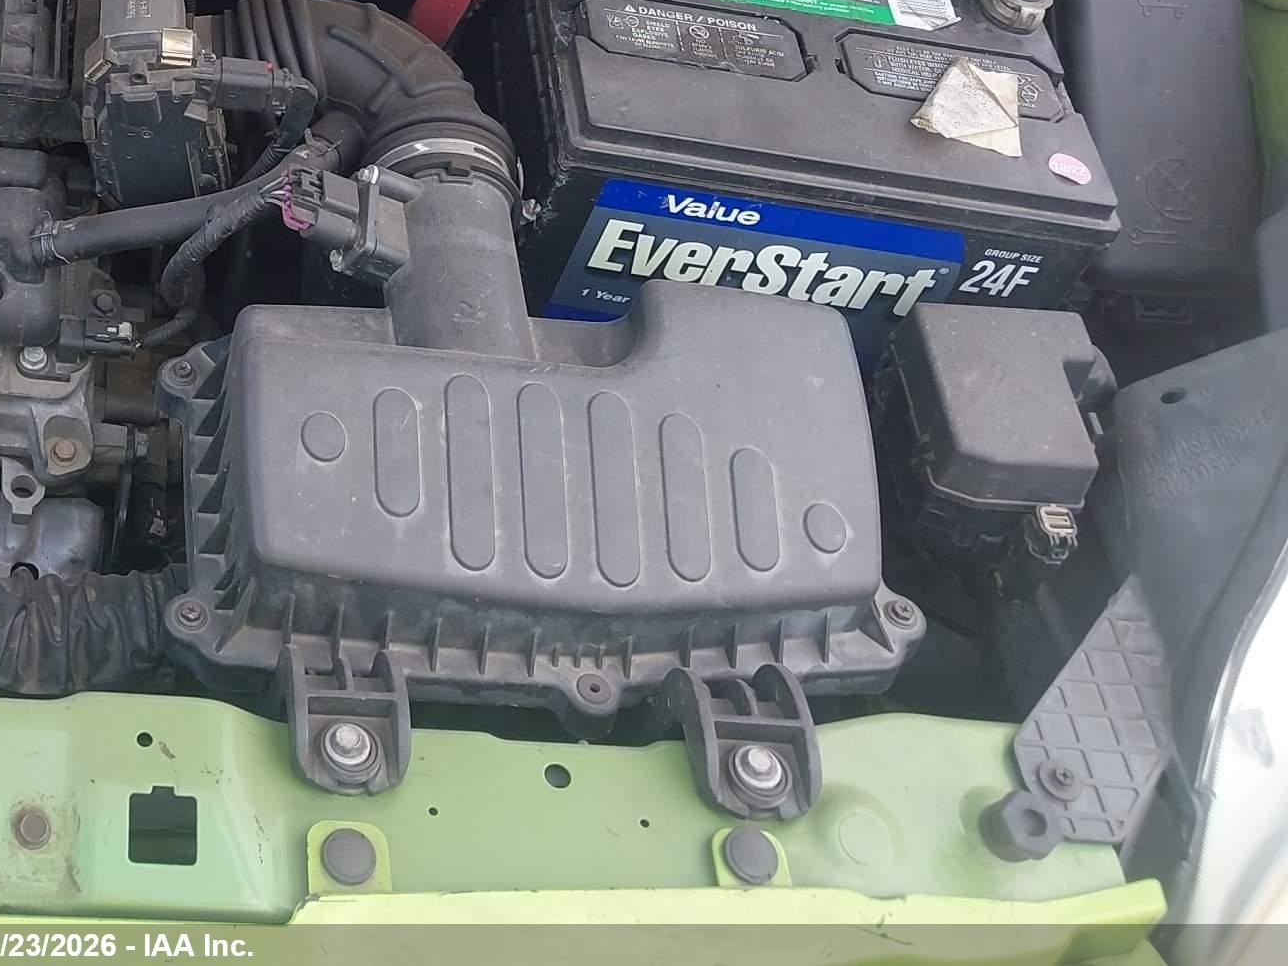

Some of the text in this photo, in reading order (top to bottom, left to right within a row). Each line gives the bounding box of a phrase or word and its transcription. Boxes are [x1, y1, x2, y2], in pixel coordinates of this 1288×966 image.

[639, 6, 757, 32] DANGER / POISON
[667, 194, 761, 226] Value
[587, 218, 936, 317] EverStart
[984, 248, 1044, 264] GROUP SIZE
[958, 260, 1039, 298] 24F
[580, 288, 631, 304] 1 Year
